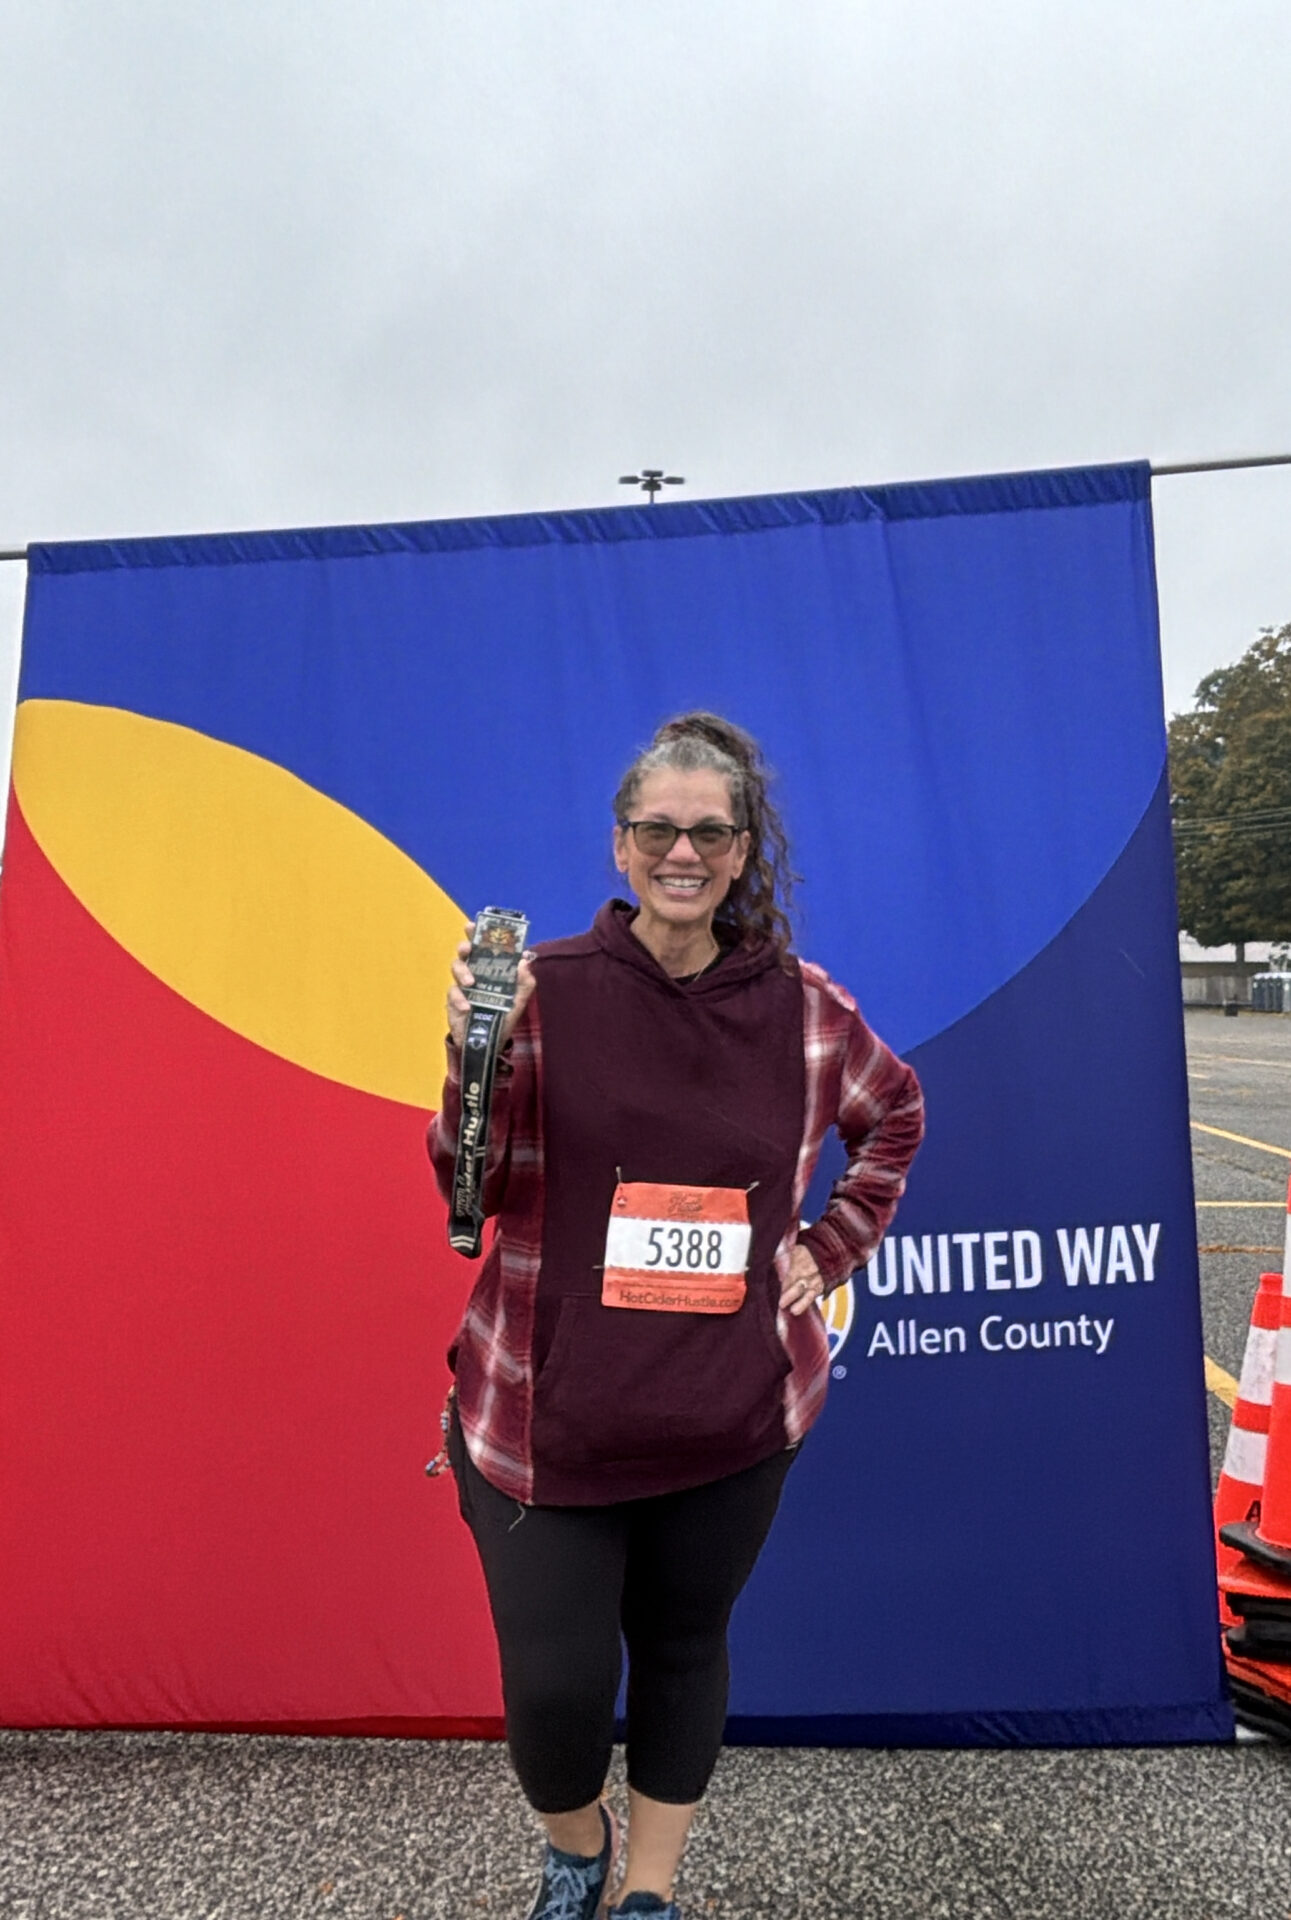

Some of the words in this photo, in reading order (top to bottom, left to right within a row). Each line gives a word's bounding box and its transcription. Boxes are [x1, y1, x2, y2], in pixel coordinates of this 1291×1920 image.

[645, 1227, 722, 1269] 5388
[867, 1230, 1043, 1296] UNITED
[1056, 1223, 1161, 1287] WAY
[867, 1319, 966, 1357] Allen
[980, 1314, 1114, 1355] County
